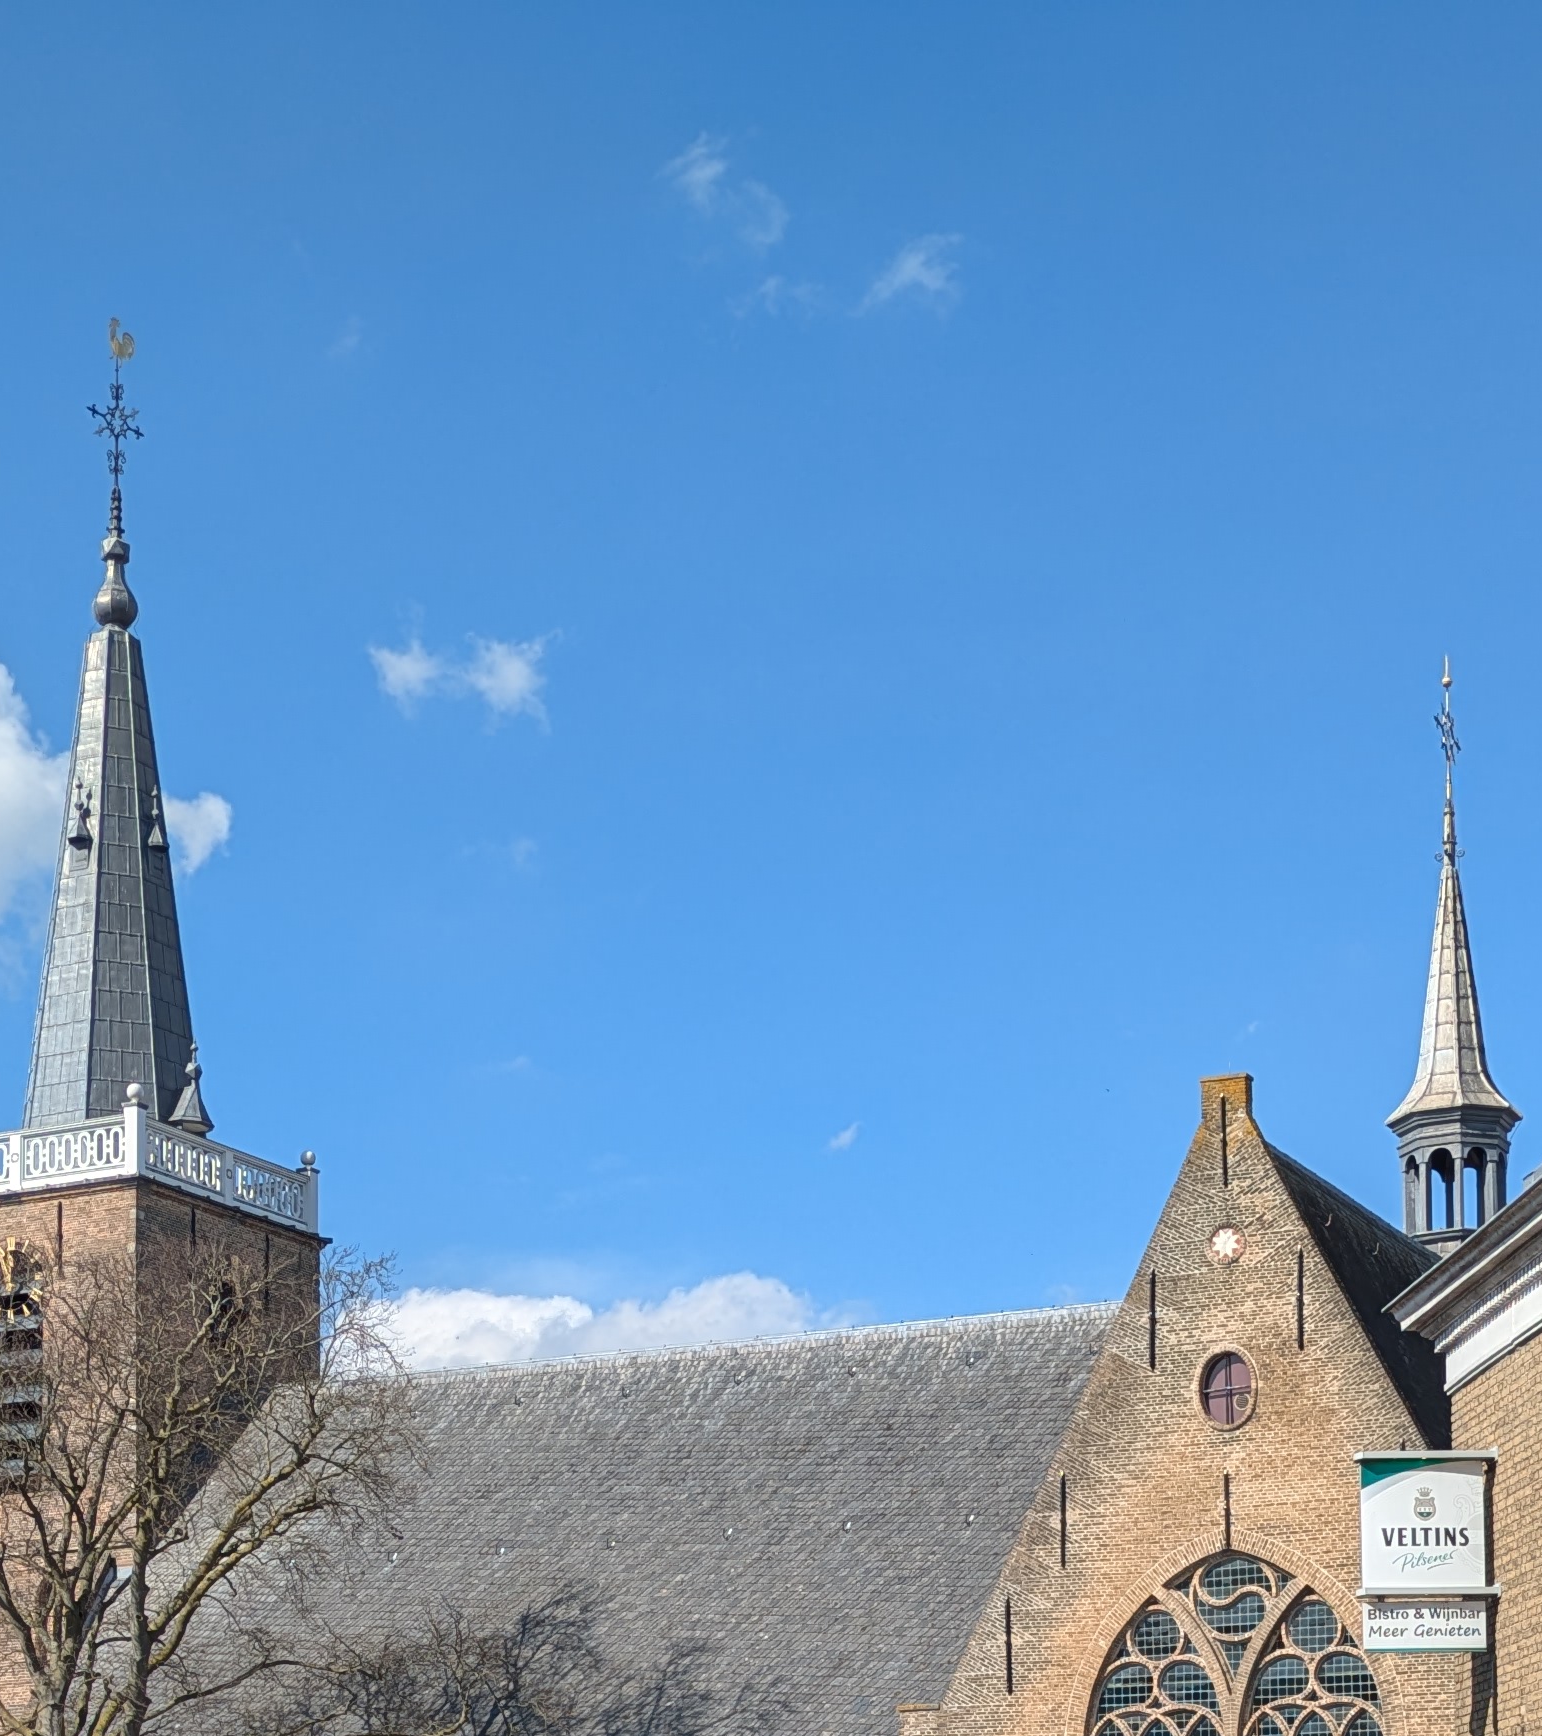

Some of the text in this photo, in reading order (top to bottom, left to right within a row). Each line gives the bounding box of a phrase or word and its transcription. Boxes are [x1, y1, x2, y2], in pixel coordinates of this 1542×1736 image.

[1381, 1527, 1470, 1547] VELTINS
[1392, 1548, 1459, 1573] Pilsener
[1367, 1605, 1482, 1622] Bistro & Wijnbar
[1368, 1623, 1482, 1638] Meer Genieten
